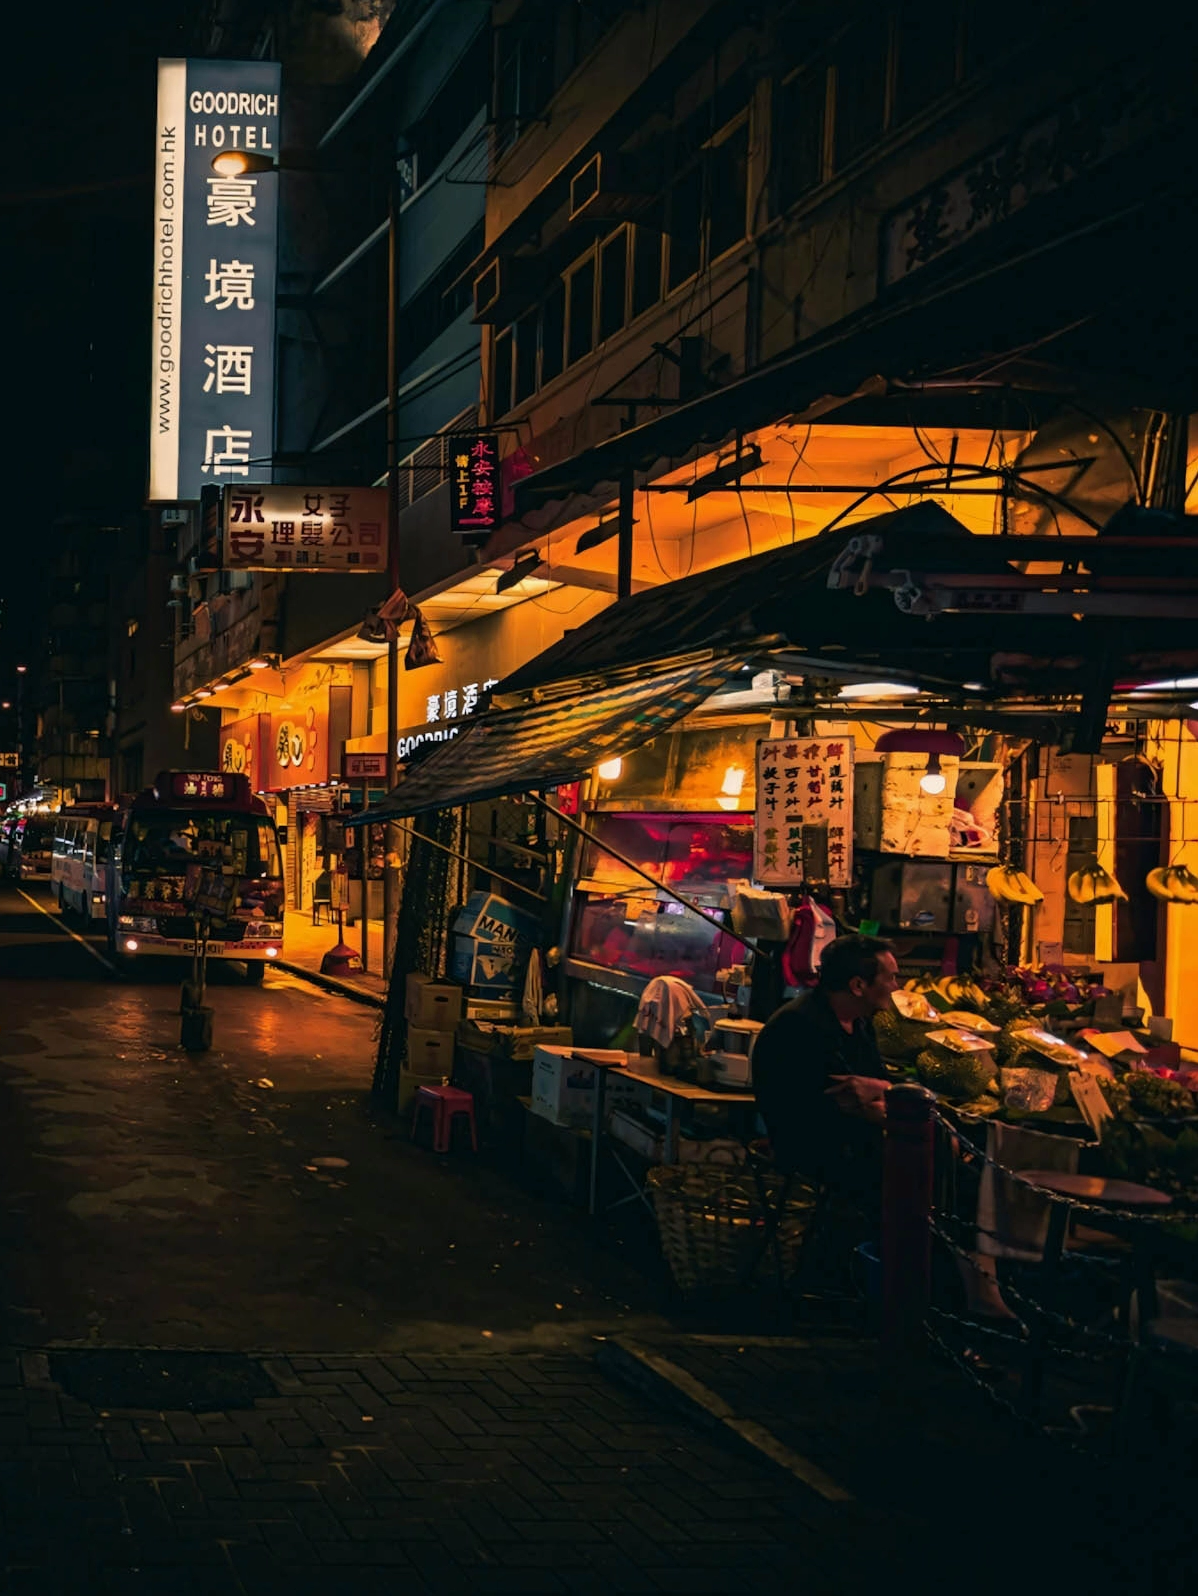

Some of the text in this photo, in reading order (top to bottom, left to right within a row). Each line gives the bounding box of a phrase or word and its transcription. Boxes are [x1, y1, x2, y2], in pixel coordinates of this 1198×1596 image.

[189, 90, 278, 116] GOODRICH
[194, 124, 273, 150] HOTEL
[157, 126, 177, 435] www.goodrichhotel.com.hk
[201, 176, 258, 477] 豪境酒店
[302, 493, 351, 517] 女子
[230, 489, 265, 564] 永安
[271, 521, 381, 546] 理髮公司
[478, 915, 521, 942] MAN
